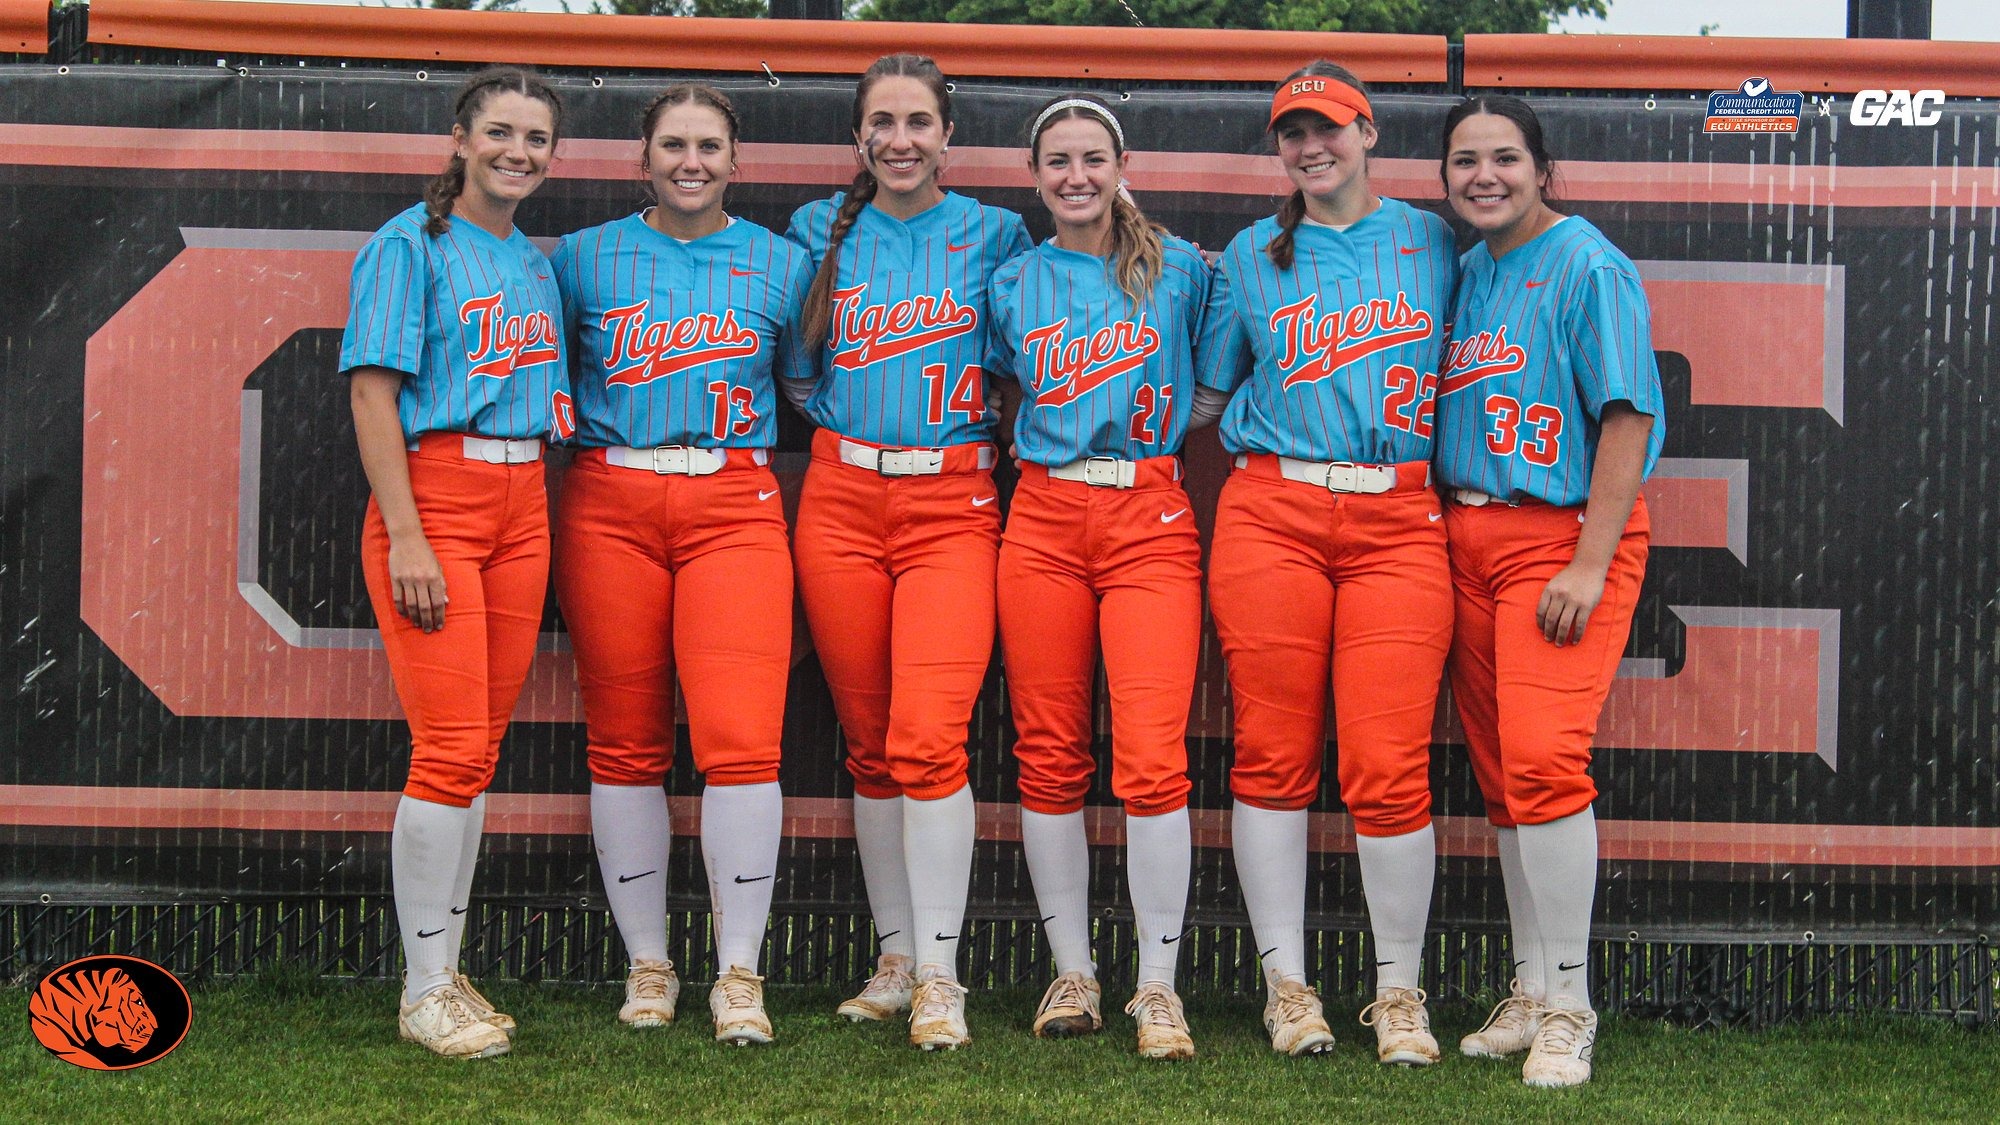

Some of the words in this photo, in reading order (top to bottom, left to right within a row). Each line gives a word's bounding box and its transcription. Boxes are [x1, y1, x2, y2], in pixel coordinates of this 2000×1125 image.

[1290, 80, 1326, 96] ECU
[601, 299, 760, 389] Tigers
[828, 283, 977, 371] Tigers
[1270, 291, 1433, 392] Tigers
[708, 380, 759, 441] 13
[921, 363, 987, 425] 14
[1383, 364, 1437, 440] 22
[1485, 393, 1564, 468] 33
